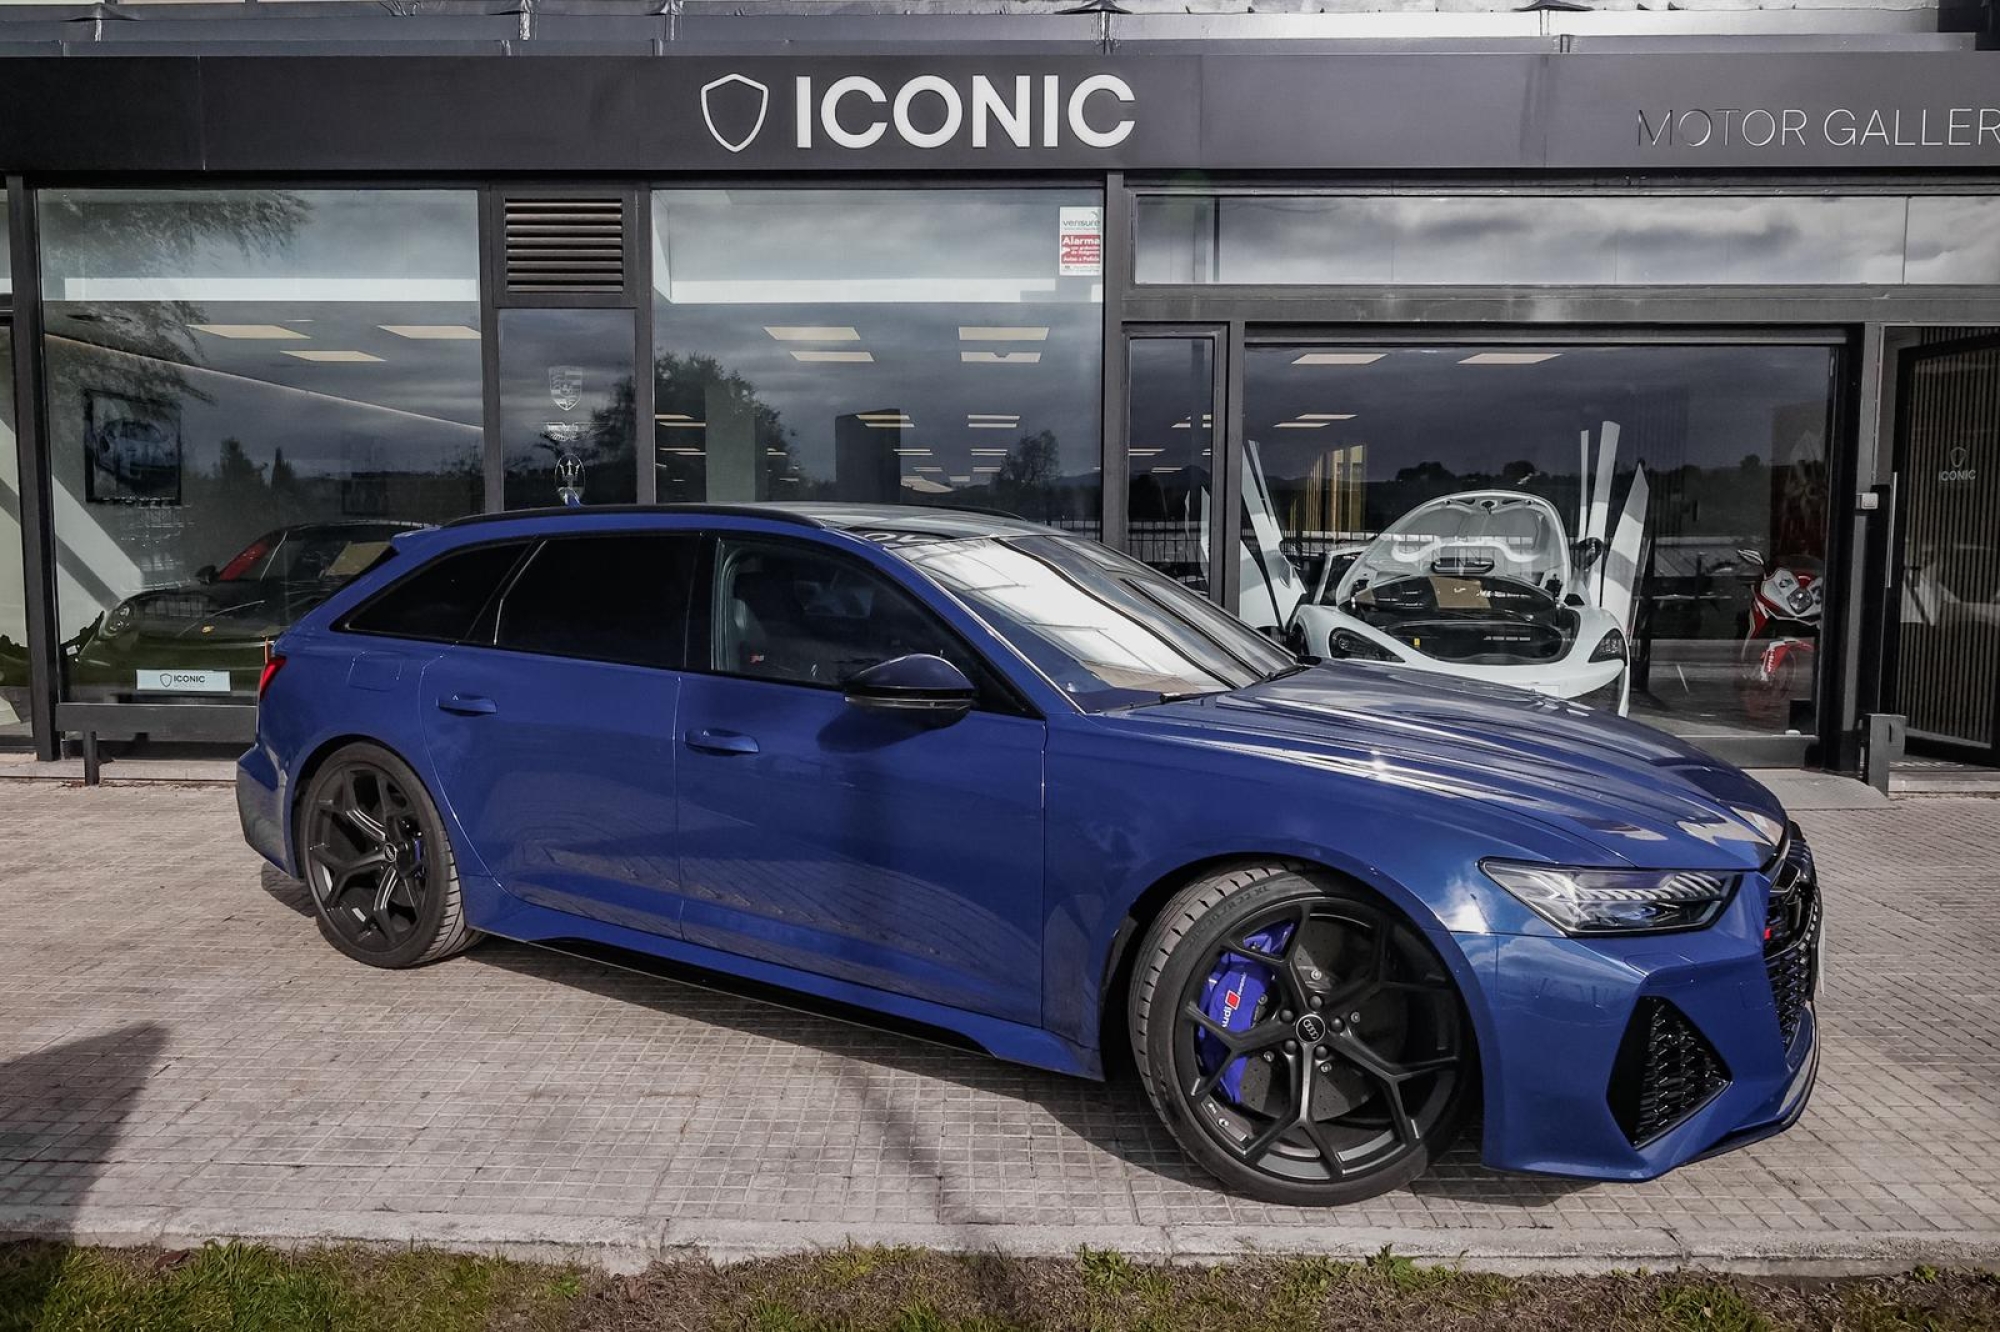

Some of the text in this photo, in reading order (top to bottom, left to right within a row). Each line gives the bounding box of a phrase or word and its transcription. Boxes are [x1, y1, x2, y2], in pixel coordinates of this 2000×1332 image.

[796, 74, 1136, 149] ICONIC
[1638, 109, 1807, 146] MOTOR
[1063, 219, 1100, 227] verisure
[1063, 236, 1100, 245] Alarma
[1938, 470, 1976, 481] ICONIC
[173, 675, 206, 683] ICONIC
